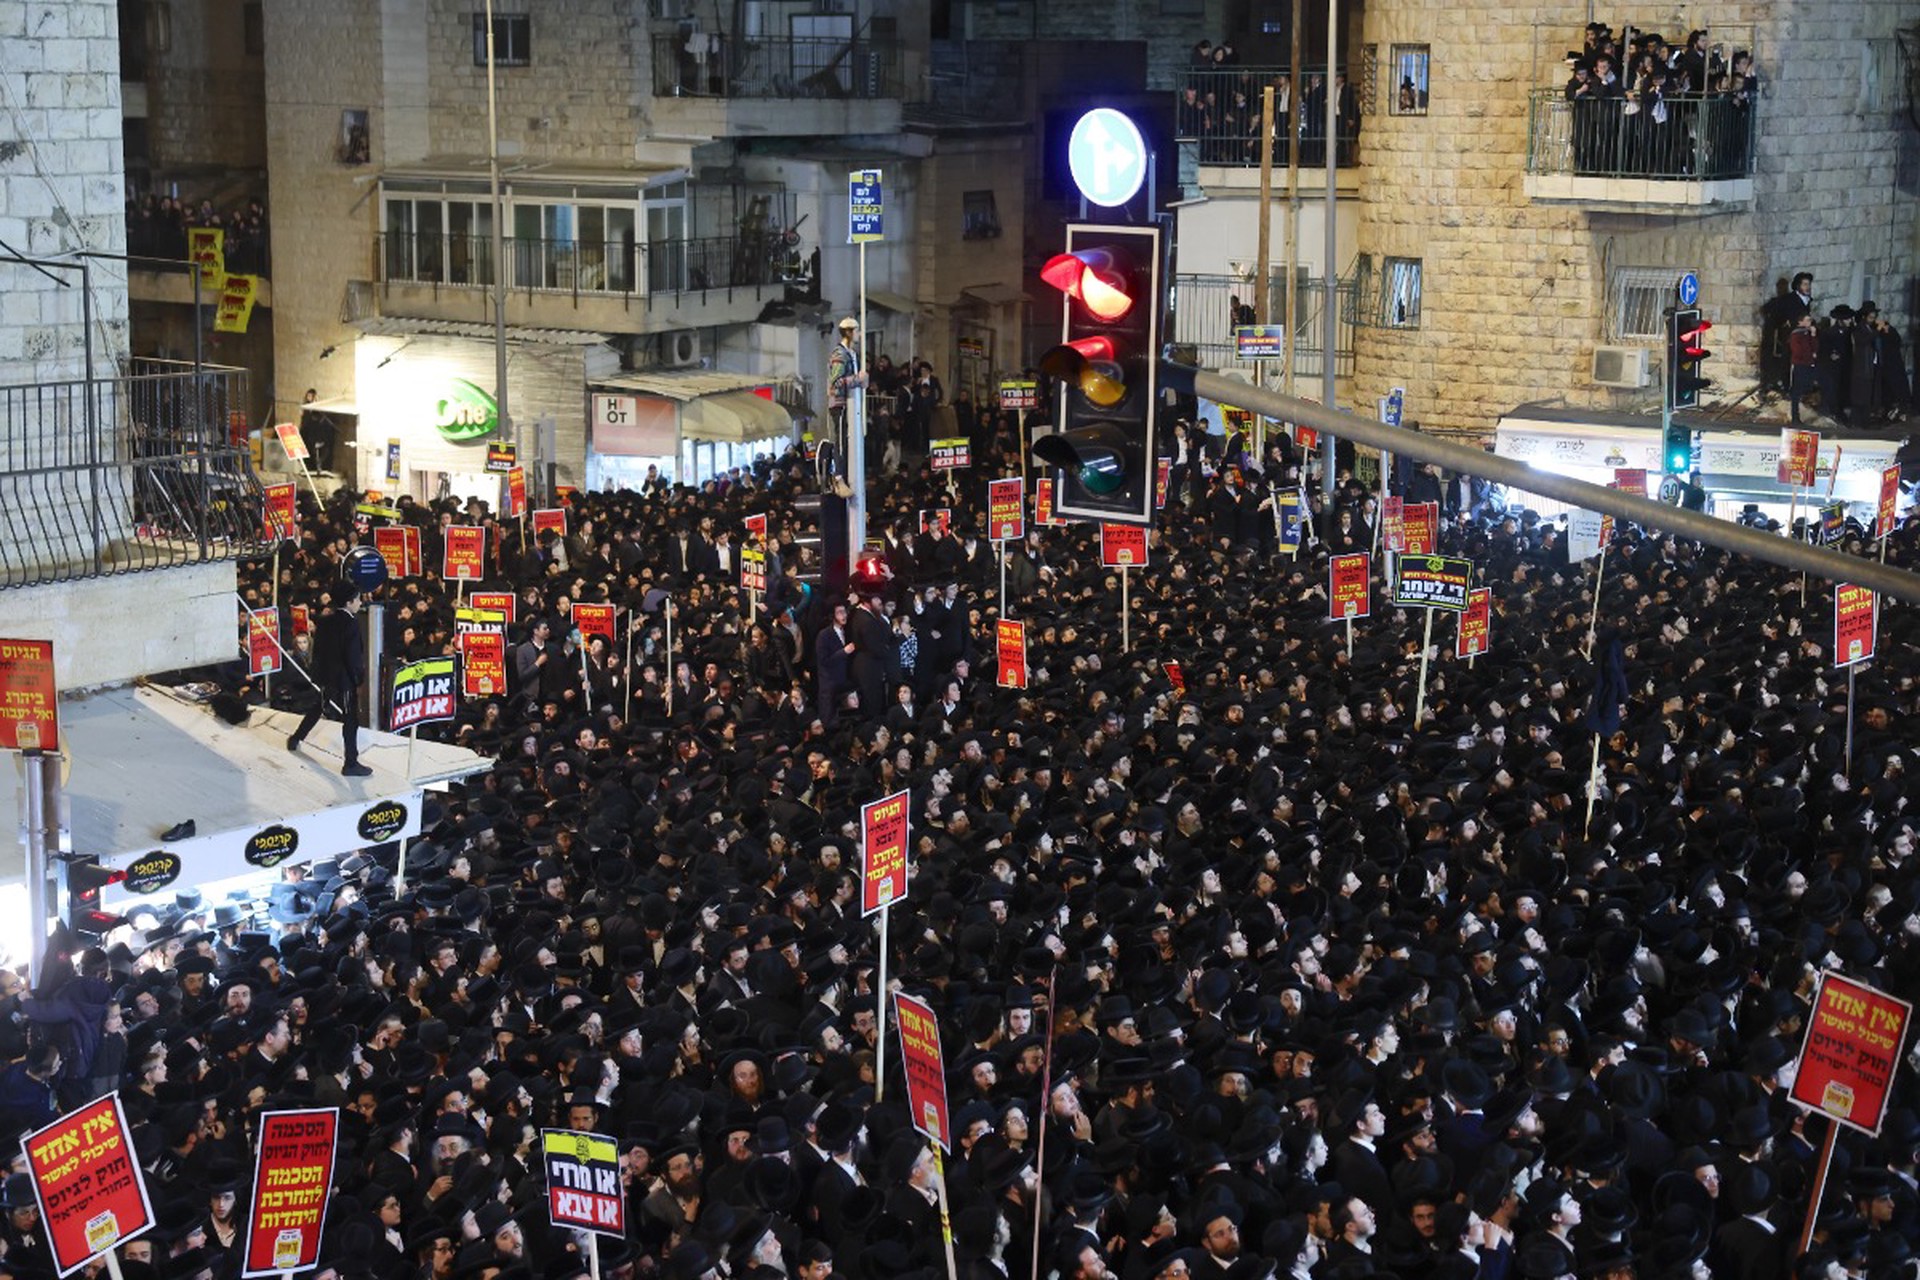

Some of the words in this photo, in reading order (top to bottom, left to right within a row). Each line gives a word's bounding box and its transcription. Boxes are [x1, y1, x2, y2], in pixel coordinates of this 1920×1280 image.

[433, 394, 487, 427] One
[1664, 483, 1678, 499] 30
[1401, 580, 1445, 594] לסחר
[1450, 586, 1465, 597] די
[2, 645, 41, 660] הגיוס
[6, 691, 45, 704] ביהרג
[396, 681, 424, 704] חרדי
[427, 678, 451, 695] או
[395, 700, 422, 725] צבא
[425, 697, 449, 715] או
[873, 802, 901, 822] הגיוס
[1825, 987, 1867, 1019] אחד
[899, 1006, 922, 1033] אחד
[1819, 1011, 1855, 1033] לאשר
[1870, 1006, 1901, 1033] אין
[1813, 1032, 1855, 1056] לגיוס
[1858, 1024, 1895, 1049] שיכול
[1857, 1050, 1888, 1072] חוק
[82, 1110, 115, 1145] אין
[271, 1120, 326, 1139] הסכמה
[33, 1129, 80, 1165] אחד
[81, 1135, 119, 1163] שיכול
[264, 1144, 299, 1161] הגיוס
[301, 1139, 330, 1161] לחוק
[40, 1156, 80, 1184] לאשר
[95, 1156, 126, 1186] חוק
[267, 1166, 324, 1186] הסכמה
[552, 1161, 592, 1191] חרדי
[595, 1168, 616, 1195] או
[47, 1173, 91, 1208] לגיוס
[96, 1175, 131, 1197] בחורי
[260, 1186, 323, 1208] להחרבת
[52, 1195, 94, 1224] ישראל
[558, 1192, 593, 1221] צבא
[596, 1198, 618, 1226] או
[259, 1208, 319, 1229] היהדות
